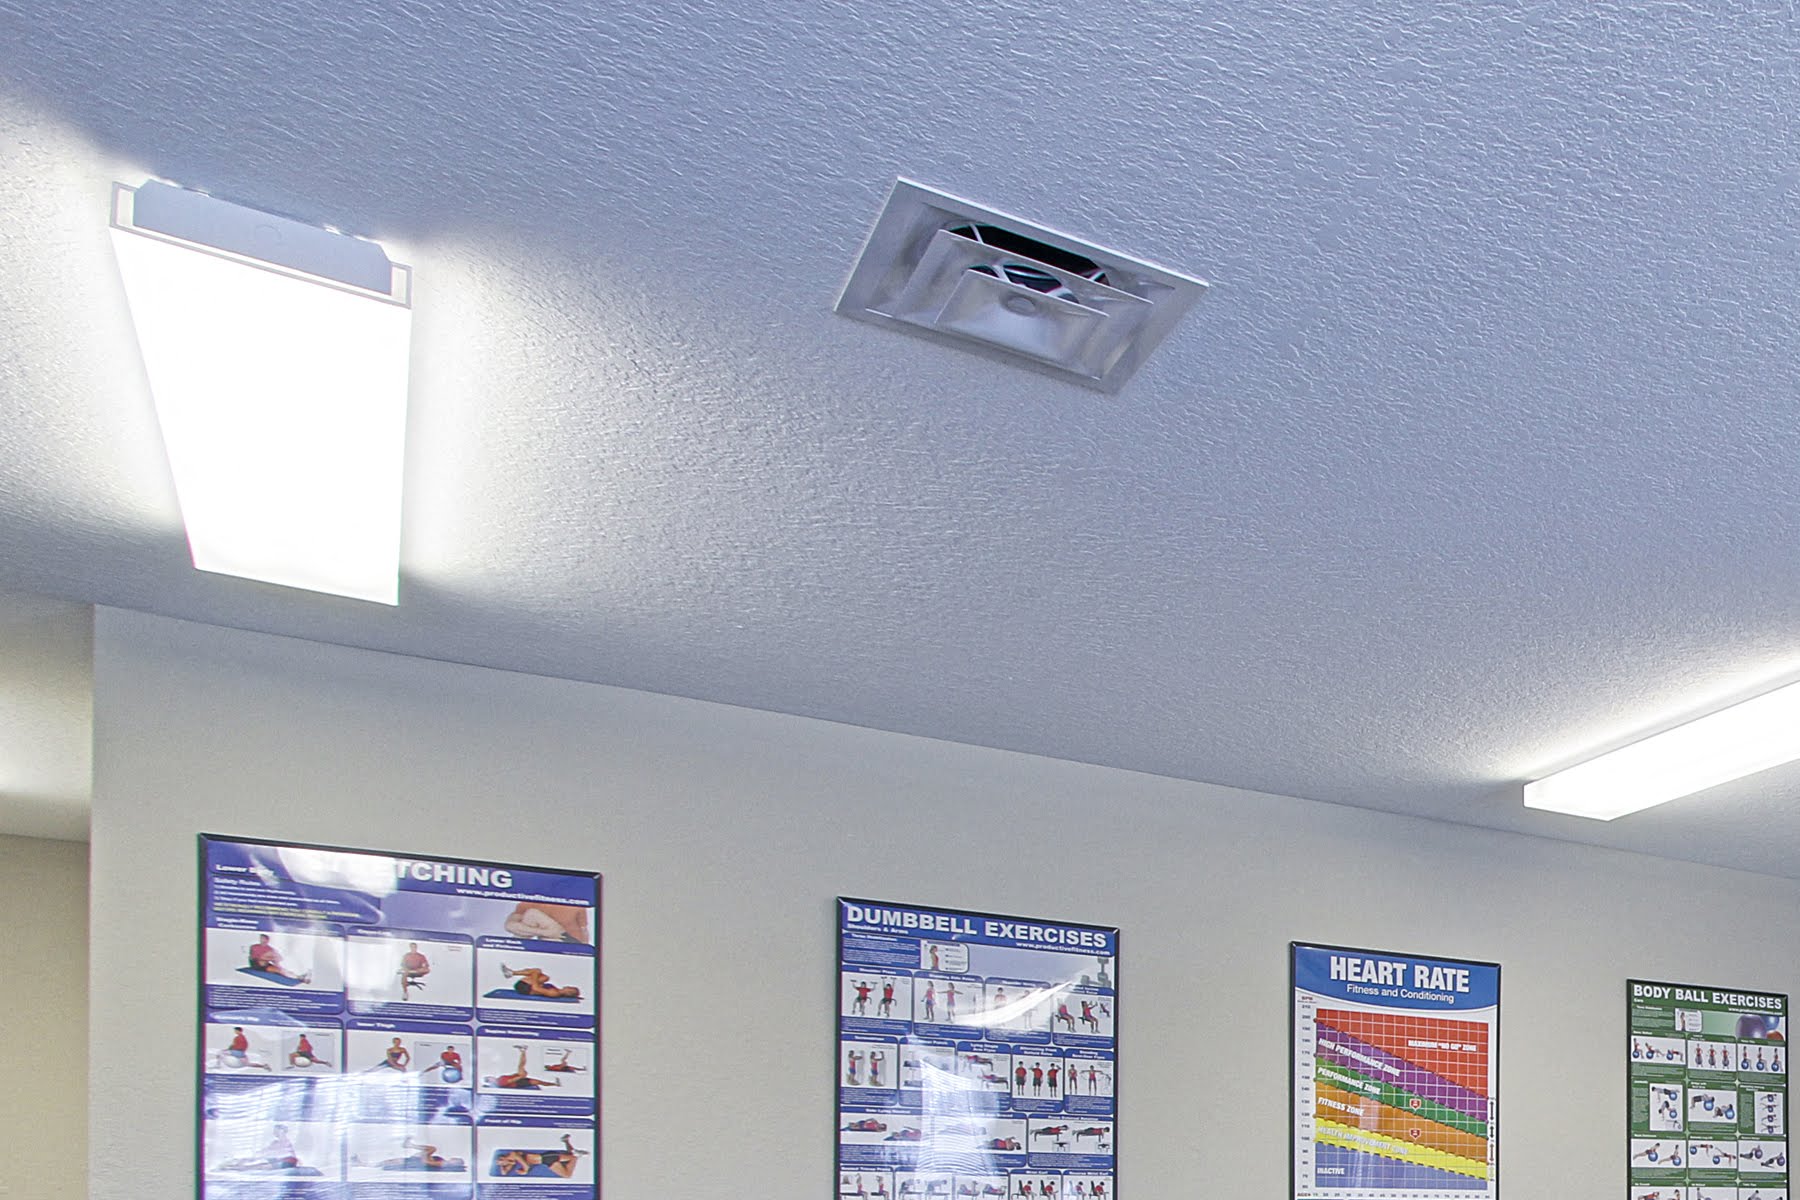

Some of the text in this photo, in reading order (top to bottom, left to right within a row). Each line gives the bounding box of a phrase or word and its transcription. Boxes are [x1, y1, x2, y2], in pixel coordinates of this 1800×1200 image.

[847, 905, 1107, 948] DUMBBELL EXERCISES
[1330, 955, 1470, 993] HEART RATE
[1347, 983, 1455, 1004] Fitness and Conditioning
[1633, 984, 1782, 1010] BODY BALL EXERCISES
[1335, 1044, 1384, 1070] PERFORMANCE
[1317, 1067, 1364, 1089] PERFORMANCE
[1318, 1097, 1346, 1111] FITNESS
[1317, 1167, 1345, 1175] INACTIVE
